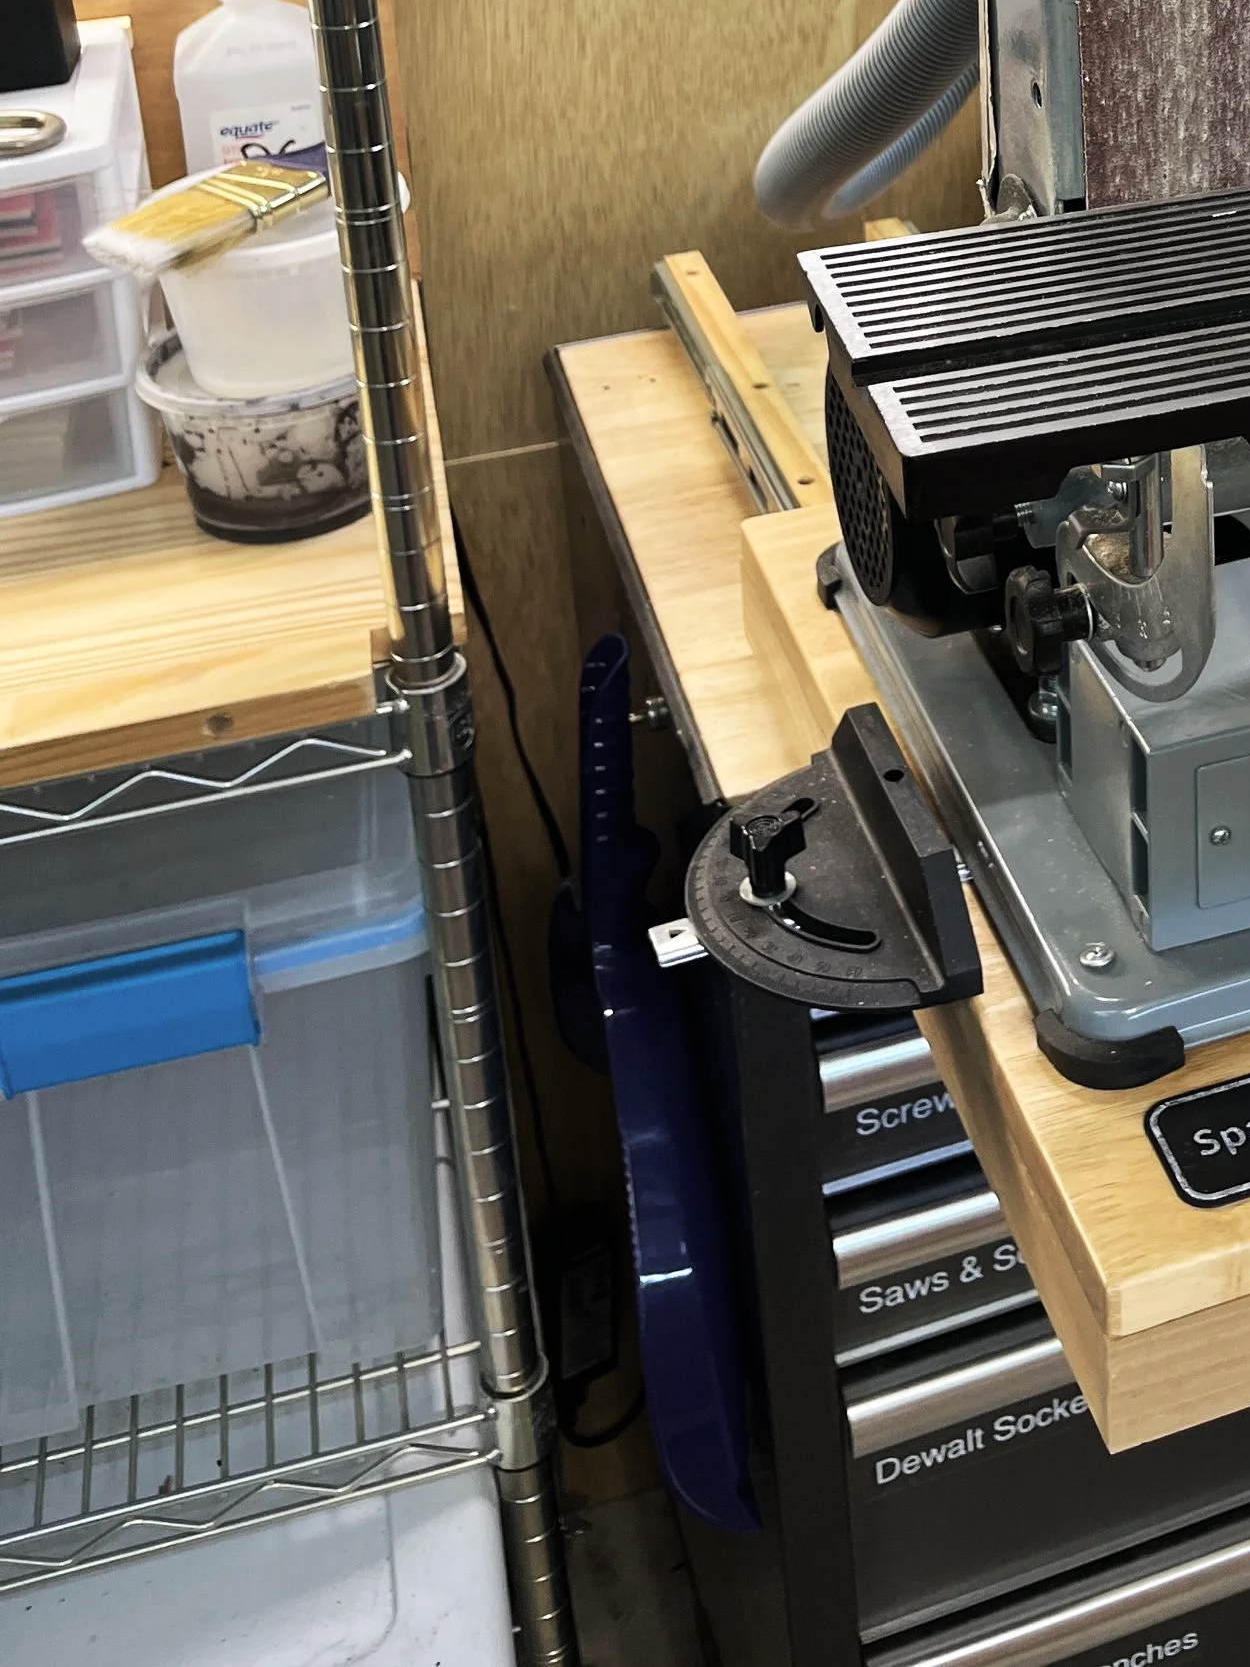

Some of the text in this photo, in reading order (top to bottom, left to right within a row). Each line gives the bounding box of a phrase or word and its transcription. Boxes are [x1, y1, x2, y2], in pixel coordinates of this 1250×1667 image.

[856, 1093, 956, 1136] Screw
[859, 1271, 949, 1313] Saws
[959, 1256, 984, 1283] &
[876, 1395, 1088, 1484] Dewalt Socke
[1100, 1632, 1199, 1667] nches
